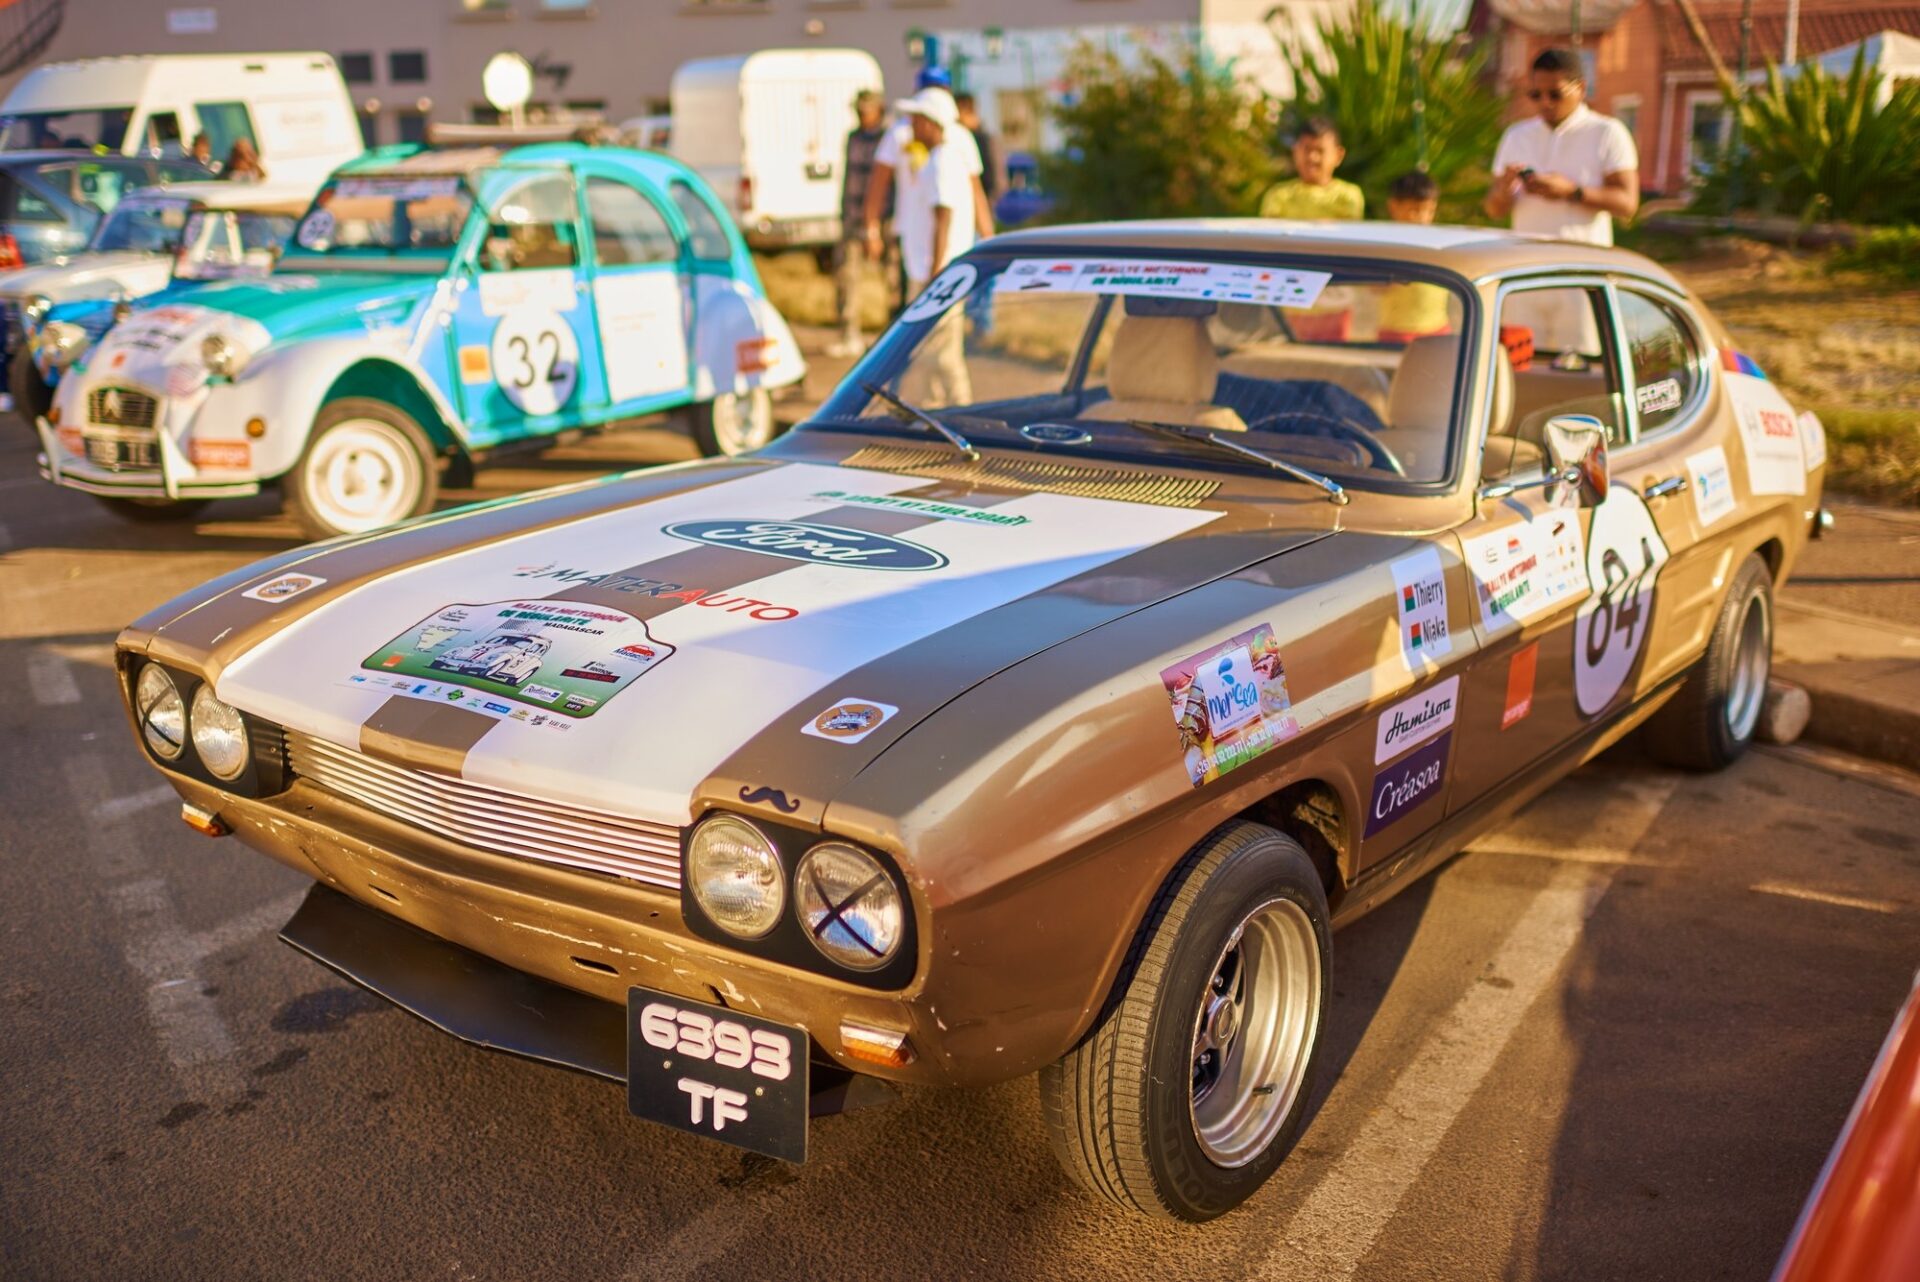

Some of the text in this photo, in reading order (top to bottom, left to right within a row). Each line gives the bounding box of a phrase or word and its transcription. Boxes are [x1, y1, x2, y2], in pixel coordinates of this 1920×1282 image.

[508, 331, 567, 388] 32
[702, 523, 896, 560] Ford
[511, 603, 556, 613] RALLYE
[1413, 580, 1443, 608] Thierry
[497, 609, 517, 618] DE
[543, 621, 604, 636] MADAGASCAR
[1422, 615, 1447, 651] Njaka
[1375, 760, 1441, 820] Créasoa
[640, 1002, 791, 1081] 6393
[677, 1077, 748, 1131] TF
